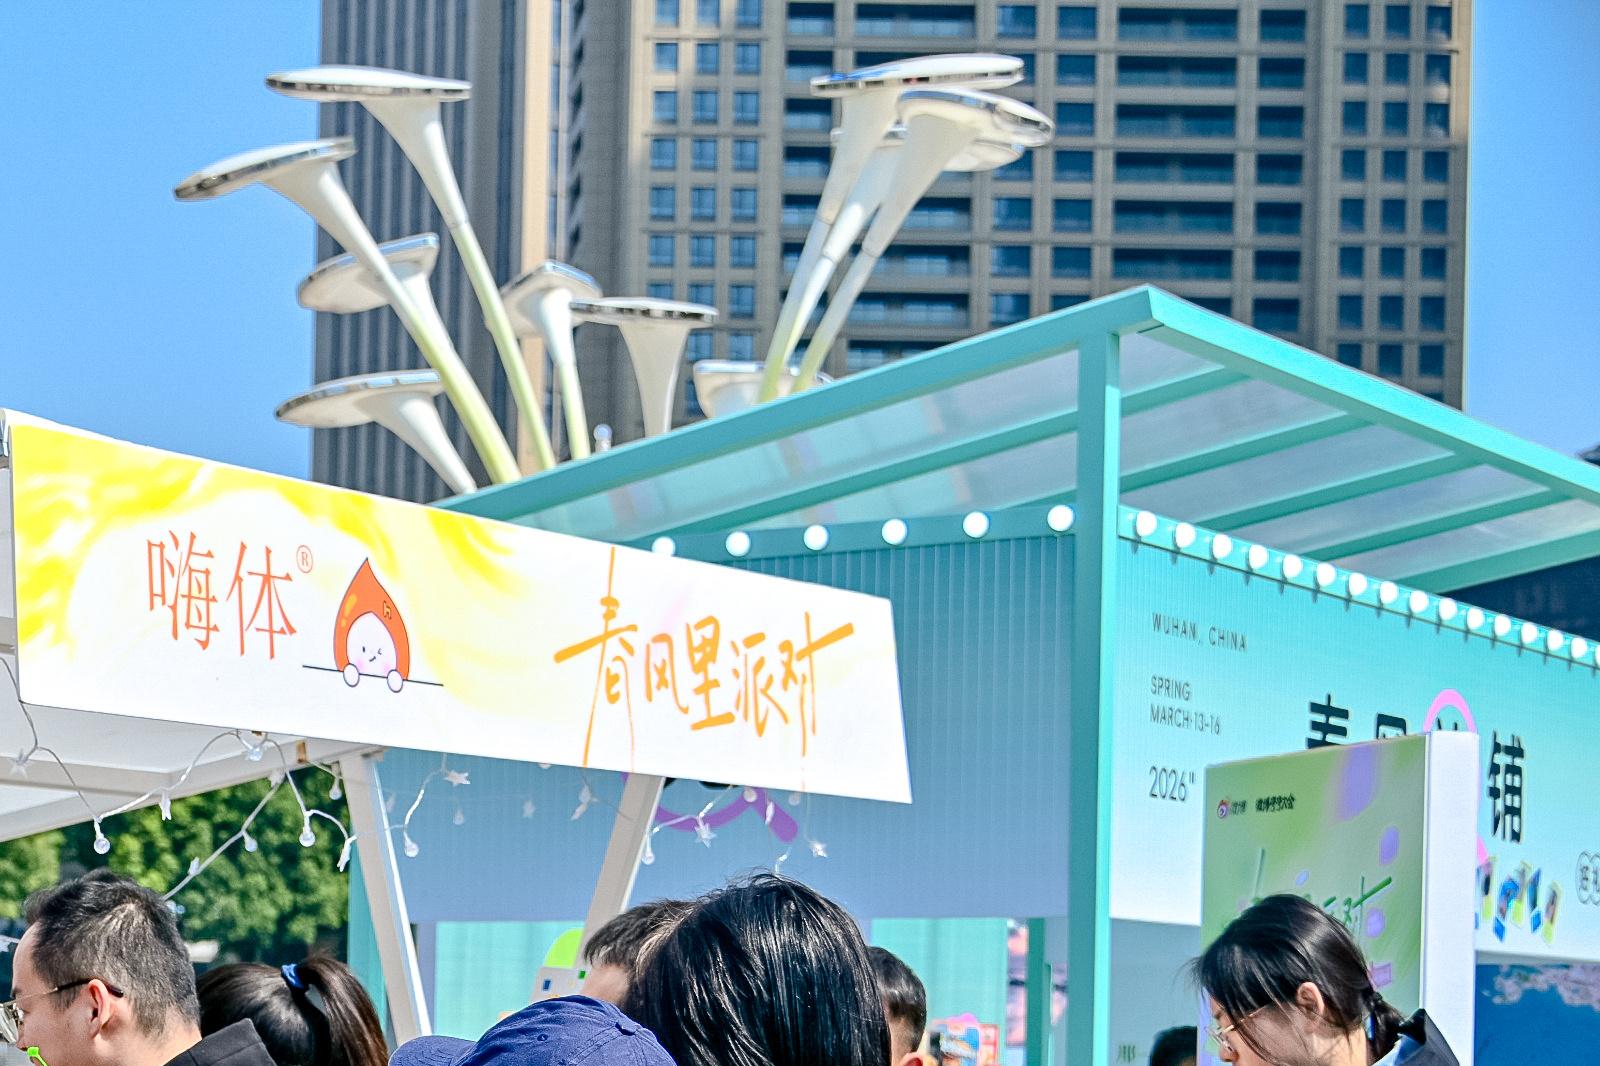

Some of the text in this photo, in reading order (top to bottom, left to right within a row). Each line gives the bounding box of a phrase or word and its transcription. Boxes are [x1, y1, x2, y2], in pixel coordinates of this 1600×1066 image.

[1208, 625, 1248, 653] CHINA
[553, 546, 855, 770] 春风里派对
[1150, 674, 1192, 702] SPRING
